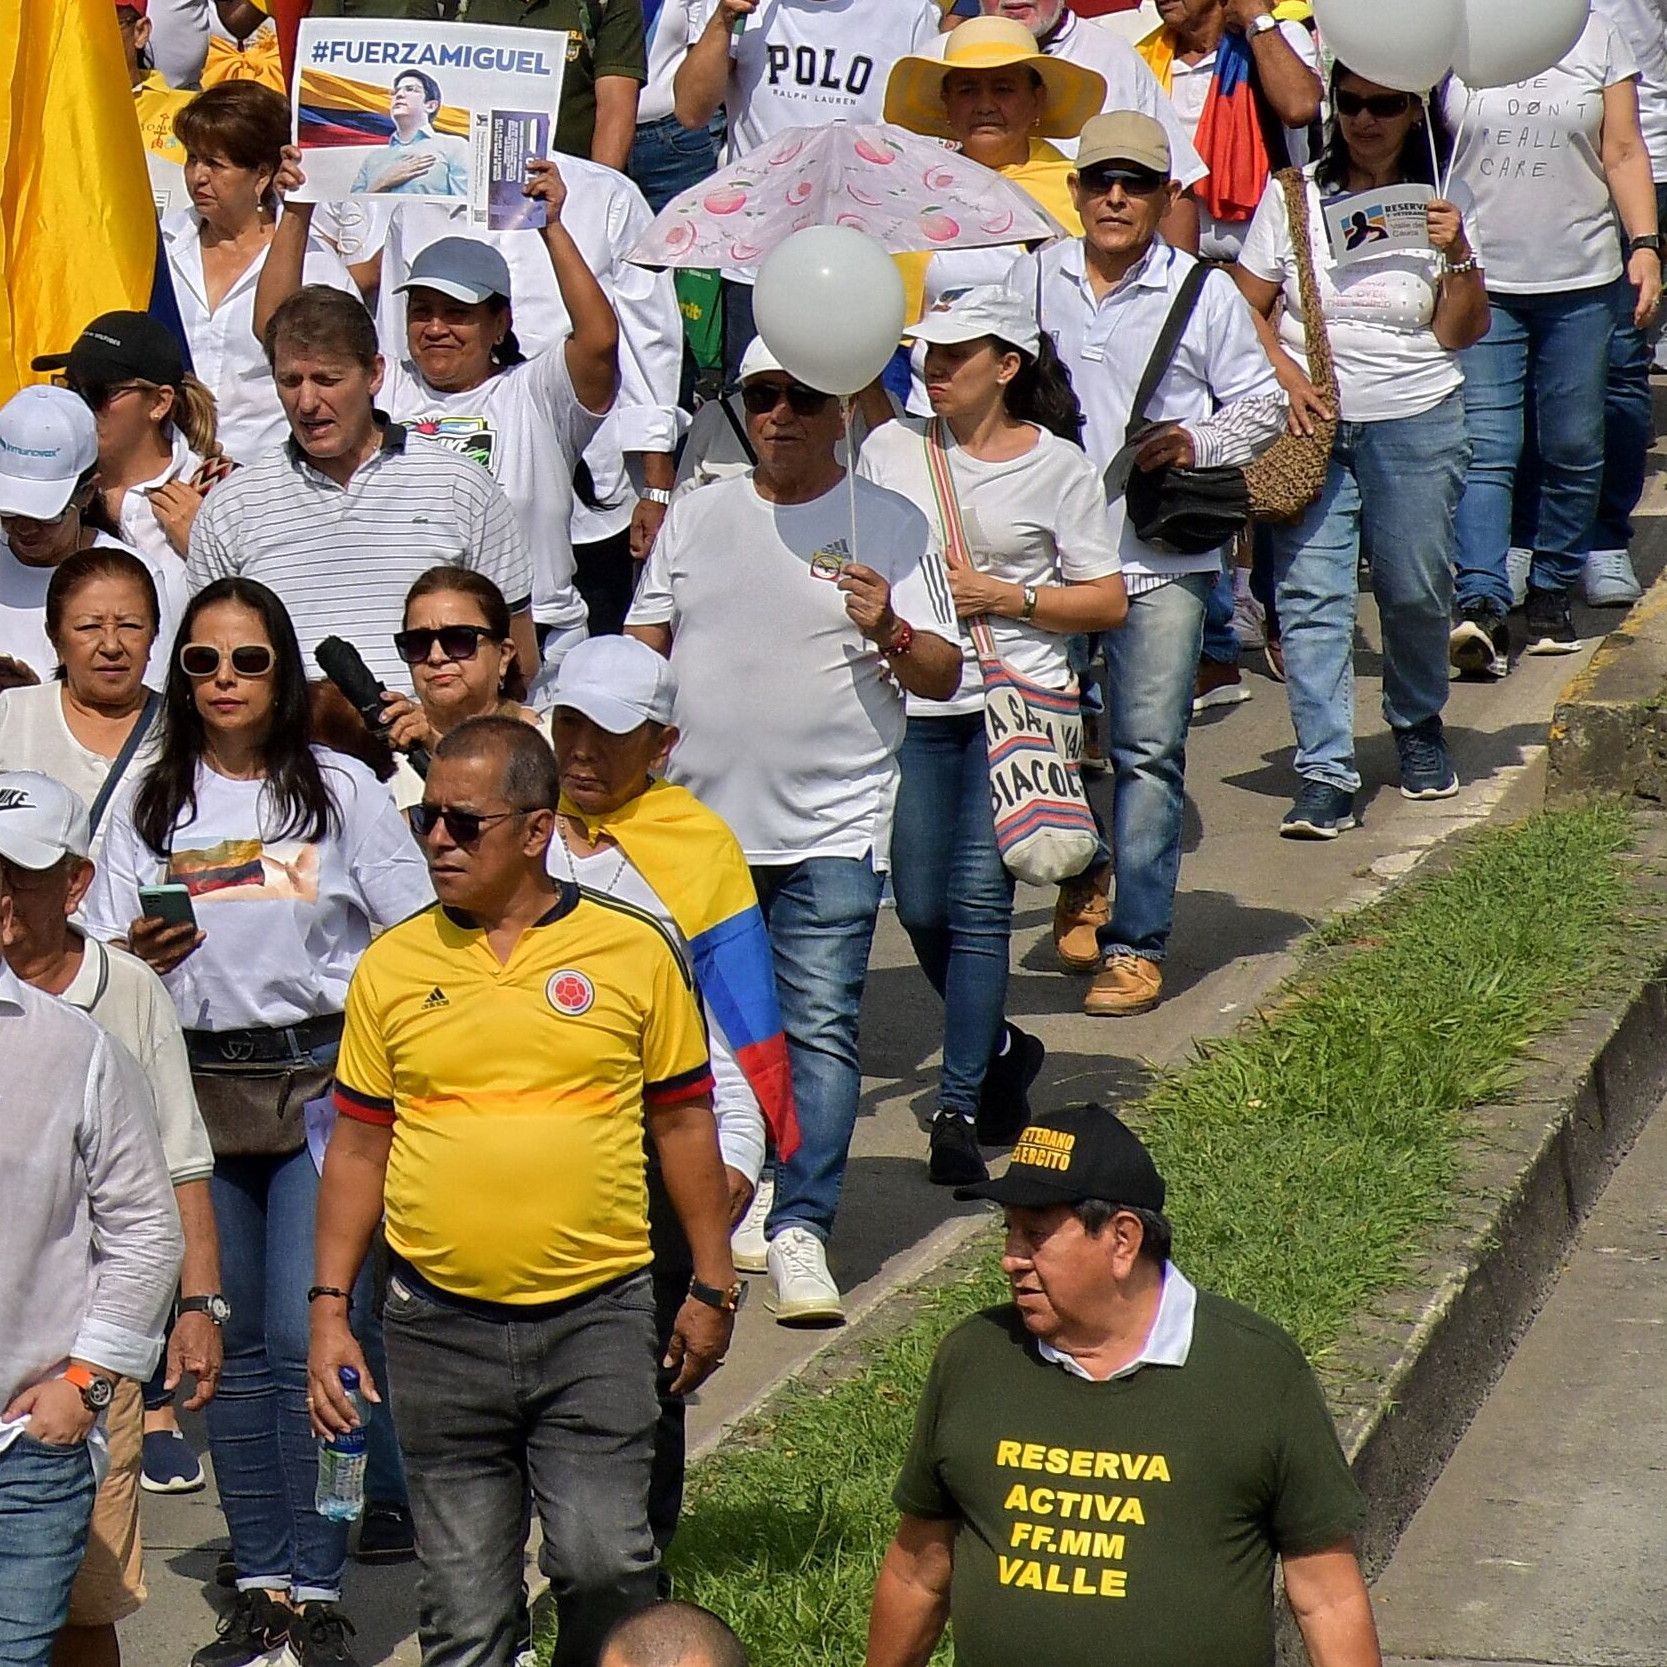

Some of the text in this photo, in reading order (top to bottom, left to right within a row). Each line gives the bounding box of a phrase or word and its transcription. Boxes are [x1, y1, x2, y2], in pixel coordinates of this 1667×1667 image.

[311, 38, 551, 77] #FUERZAMIGUEL
[767, 44, 874, 95] POLO
[772, 89, 857, 106] RALPH LAUREN
[996, 1440, 1172, 1484] RESERVA
[1003, 1483, 1146, 1527] ACTIVA
[1009, 1522, 1125, 1561] FF.MM
[998, 1555, 1128, 1599] VALLE
